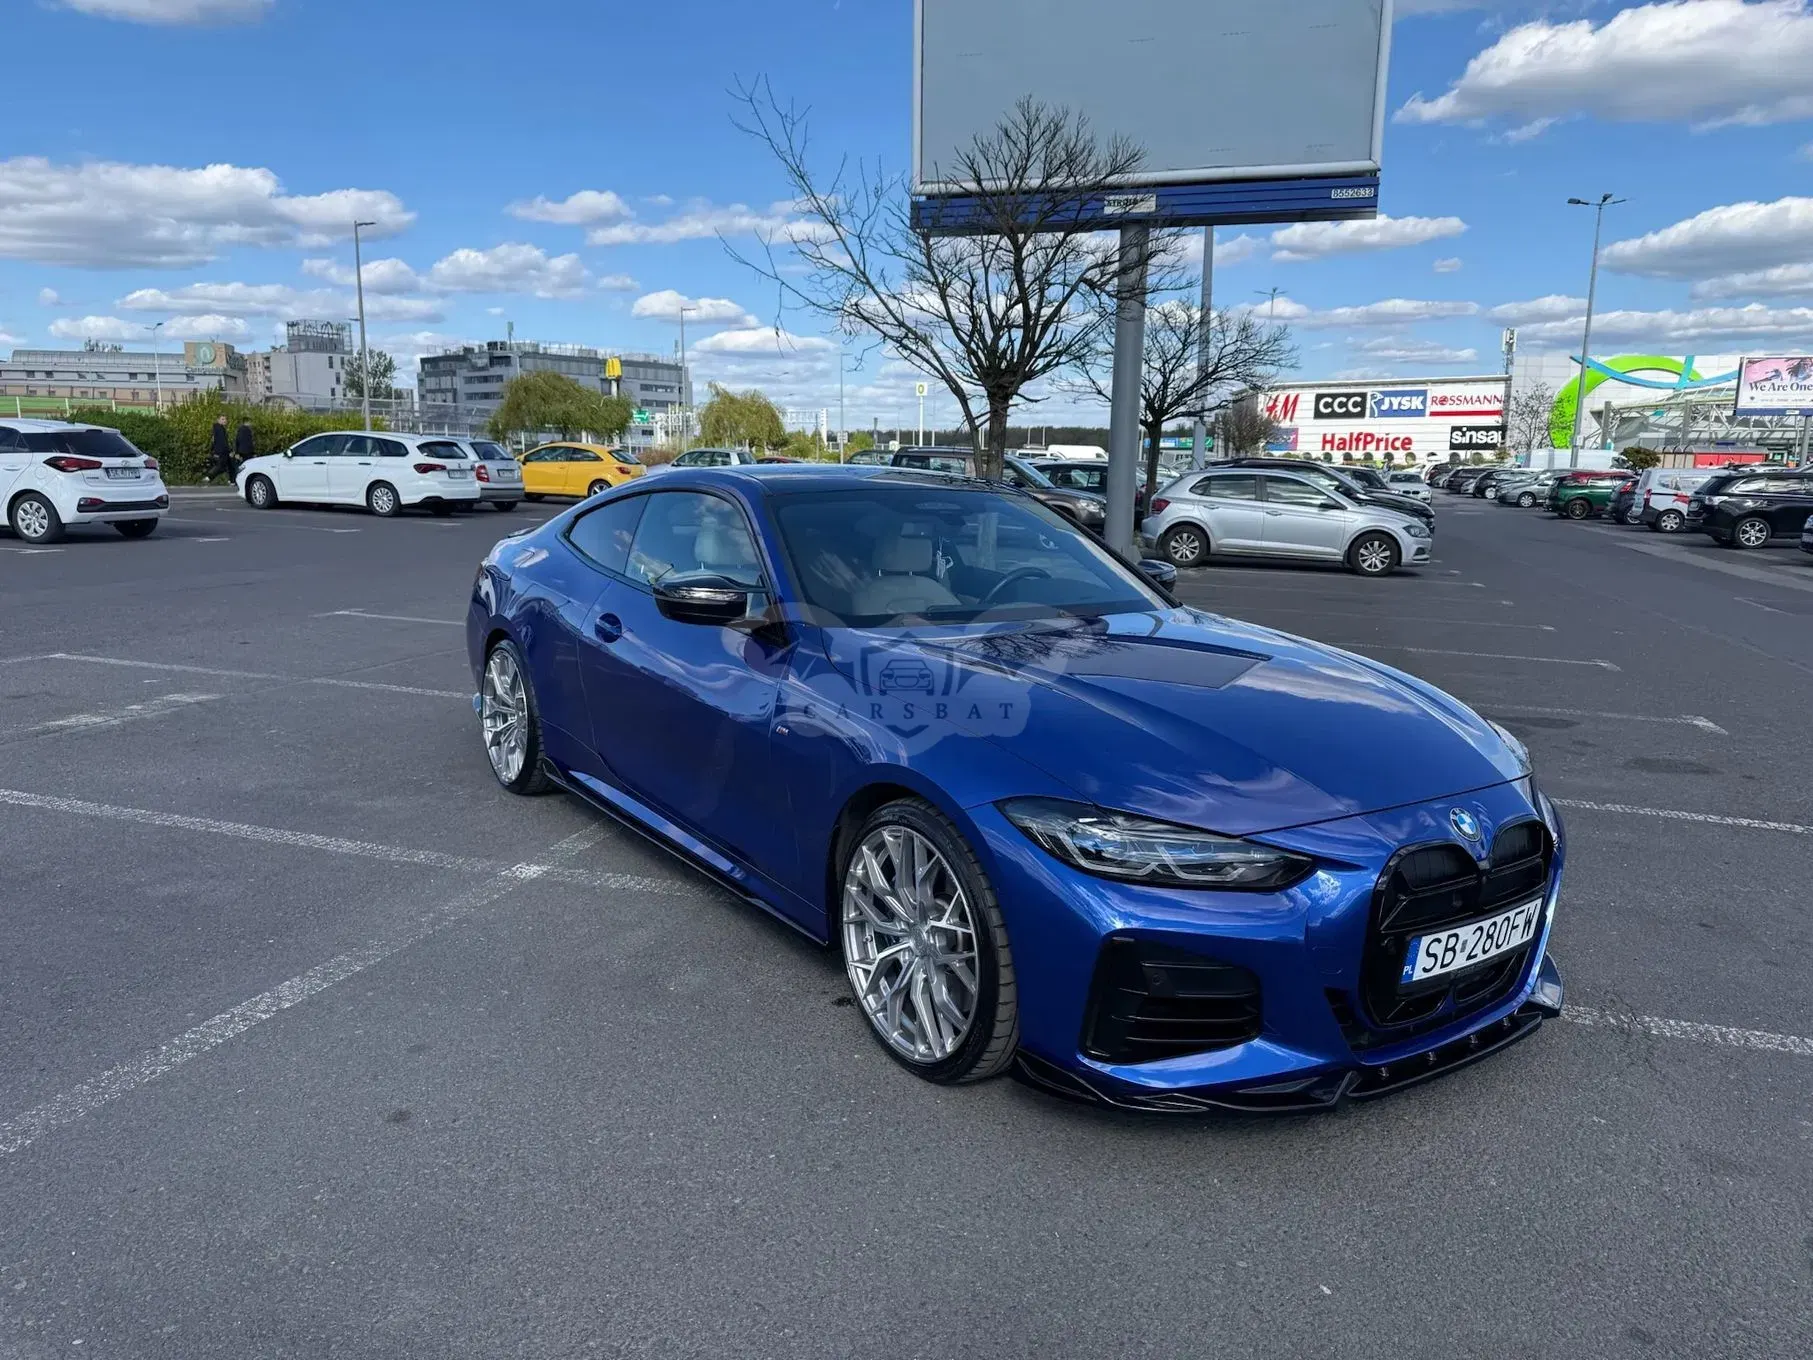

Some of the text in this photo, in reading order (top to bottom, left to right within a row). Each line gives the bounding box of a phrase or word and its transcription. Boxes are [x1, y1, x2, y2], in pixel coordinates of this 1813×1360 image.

[1749, 382, 1813, 392] We Are One
[1319, 397, 1362, 413] CCC
[1381, 396, 1424, 410] JYSK
[1431, 394, 1503, 406] ROSSMANN
[1321, 432, 1413, 451] HalfPrice
[1422, 933, 1460, 973] SB
[1402, 965, 1413, 975] PL
